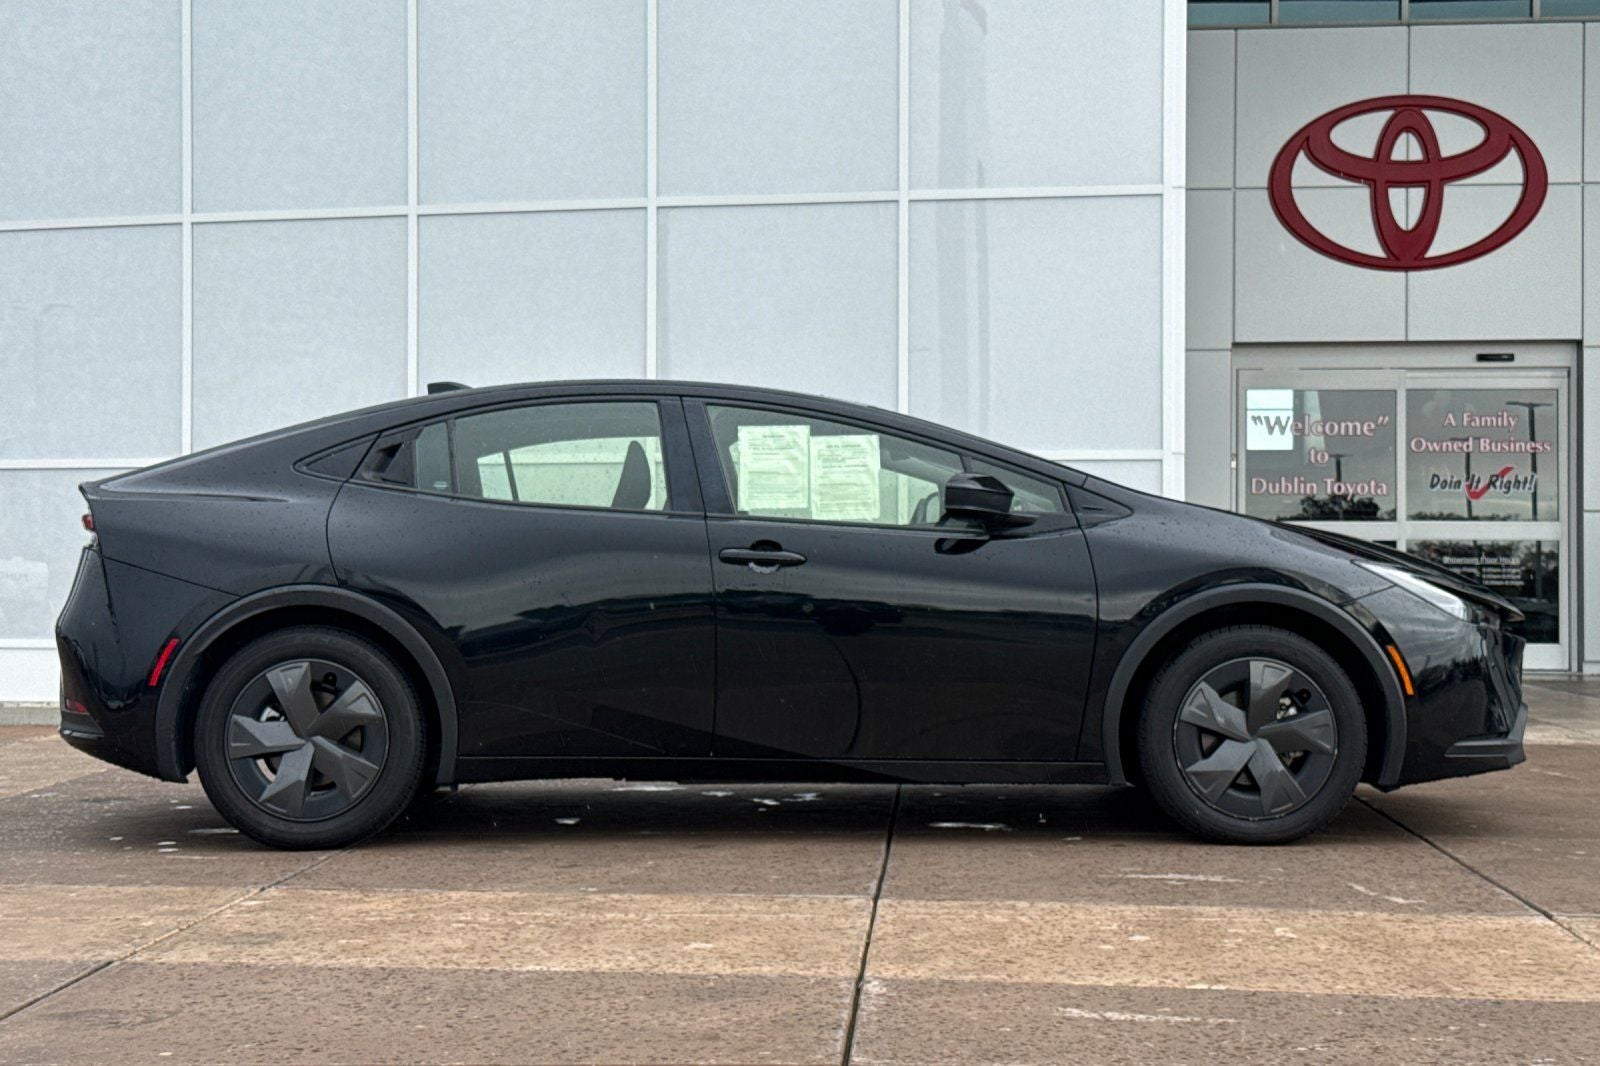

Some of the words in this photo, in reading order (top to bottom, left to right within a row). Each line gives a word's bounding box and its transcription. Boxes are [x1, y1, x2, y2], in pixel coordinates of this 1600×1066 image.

[1443, 412, 1456, 427] A
[1463, 411, 1517, 432] Family
[1410, 436, 1473, 452] Owned
[1480, 436, 1551, 452] Business
[1310, 448, 1329, 463] to
[1251, 476, 1317, 495] Dublin
[1323, 478, 1387, 500] Toyota
[1469, 474, 1481, 490] It
[1487, 474, 1535, 494] Right!
